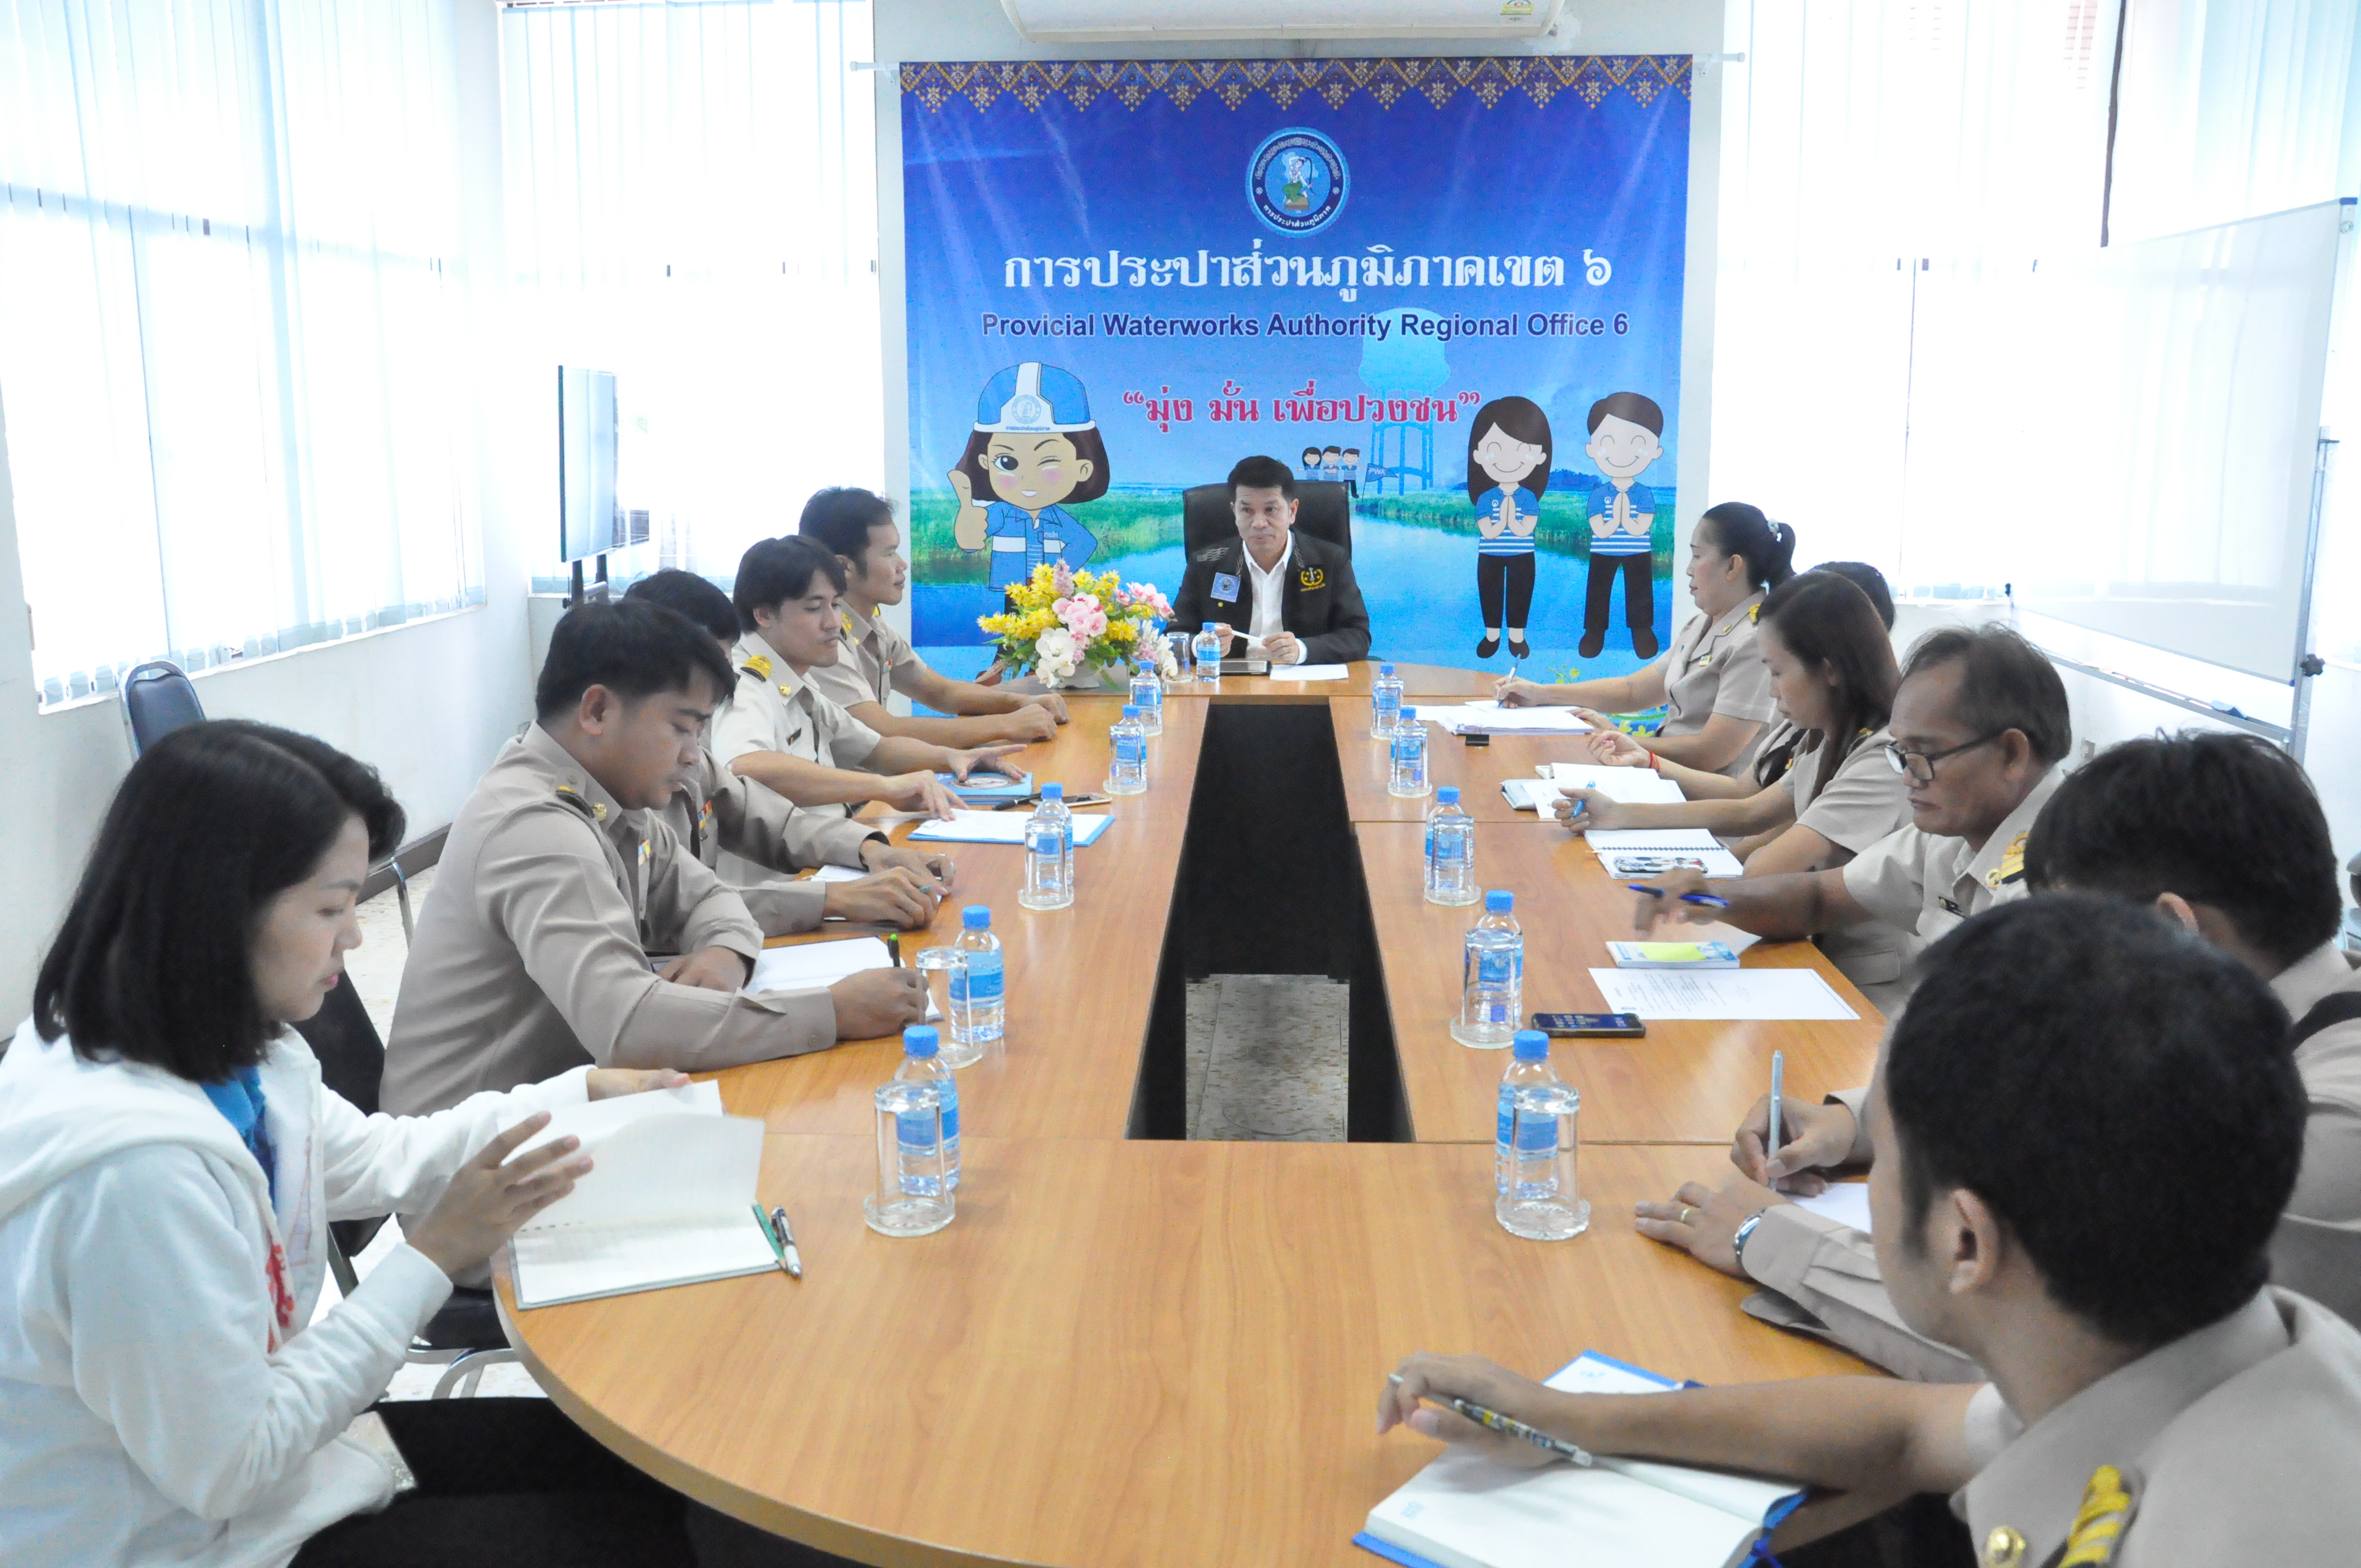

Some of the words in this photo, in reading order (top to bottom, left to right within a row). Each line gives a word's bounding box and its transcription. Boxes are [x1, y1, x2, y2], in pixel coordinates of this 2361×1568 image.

[1004, 238, 1565, 302] การประปาส่วนภูมิภาคเขต
[1582, 248, 1612, 286] ๖
[982, 313, 1095, 336] Provicial
[1102, 313, 1259, 336] Waterworks
[1266, 313, 1392, 341] Authority
[1401, 313, 1518, 341] Regional
[1527, 312, 1605, 336] Office
[1613, 312, 1629, 336] 6
[1209, 380, 1260, 422] มั่น
[1369, 467, 1386, 476] PWA
